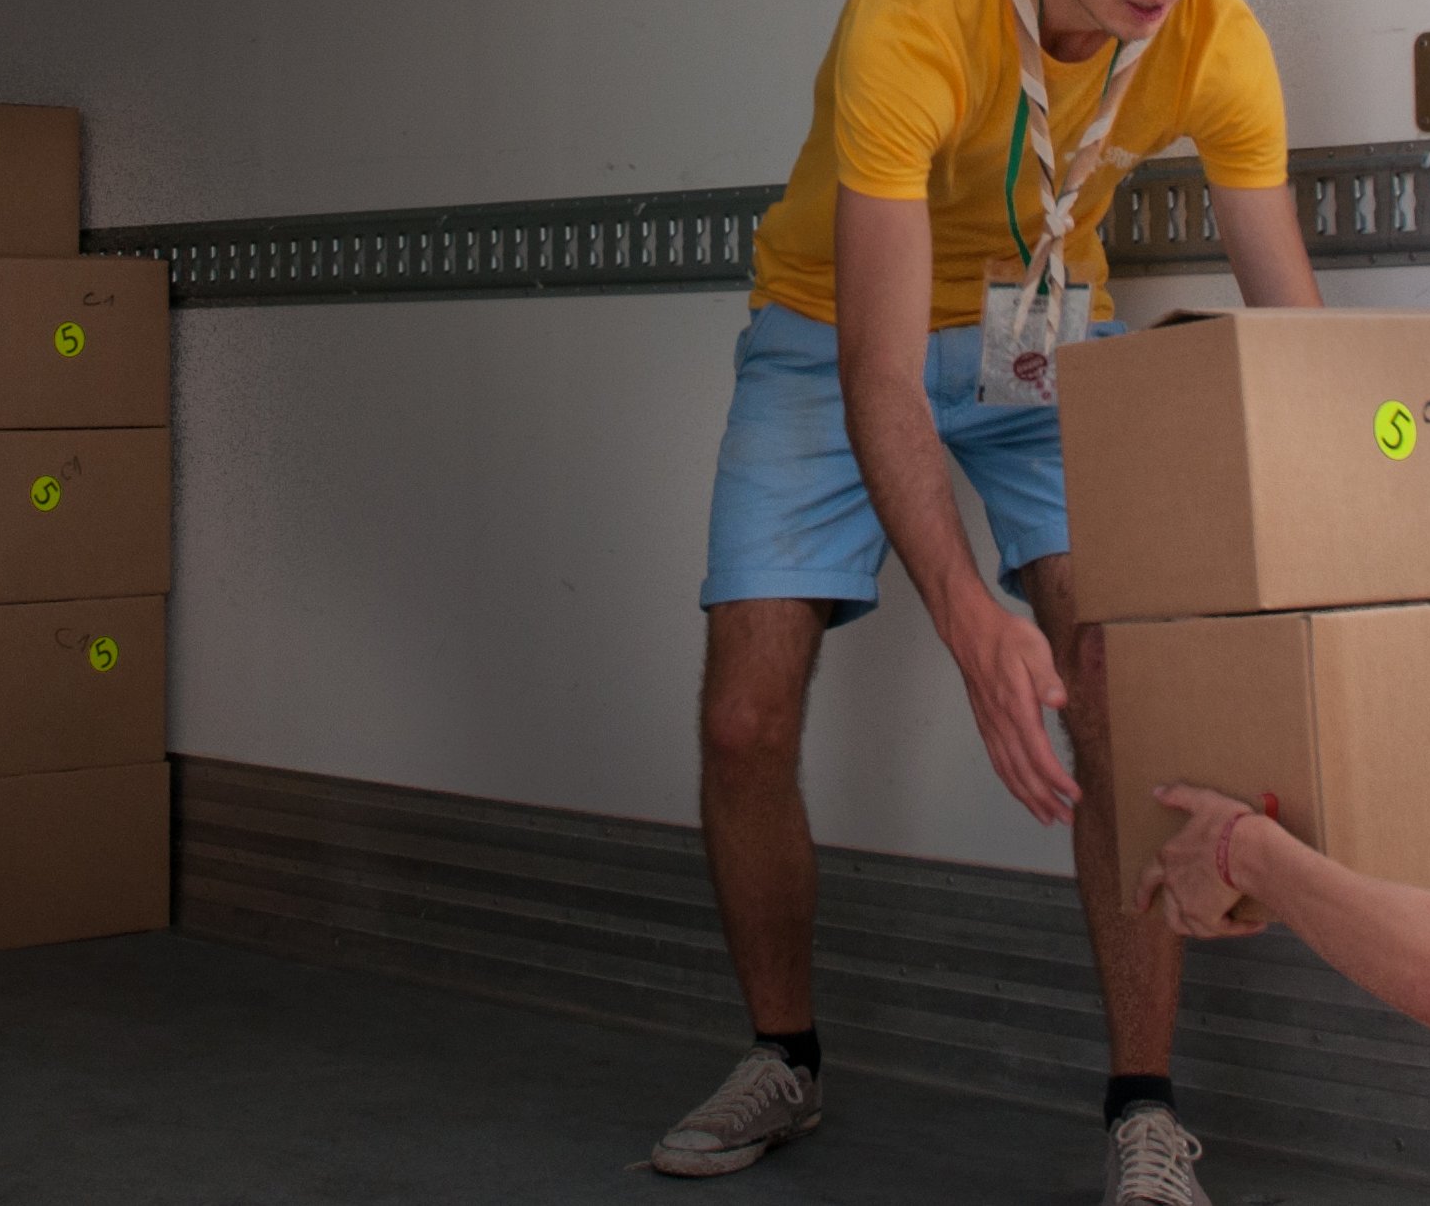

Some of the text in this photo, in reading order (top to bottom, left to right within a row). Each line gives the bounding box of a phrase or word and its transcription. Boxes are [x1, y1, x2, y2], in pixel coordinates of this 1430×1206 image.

[61, 325, 79, 354] 5
[1381, 408, 1411, 451] 5
[33, 480, 59, 505] 5
[95, 638, 113, 669] 5
